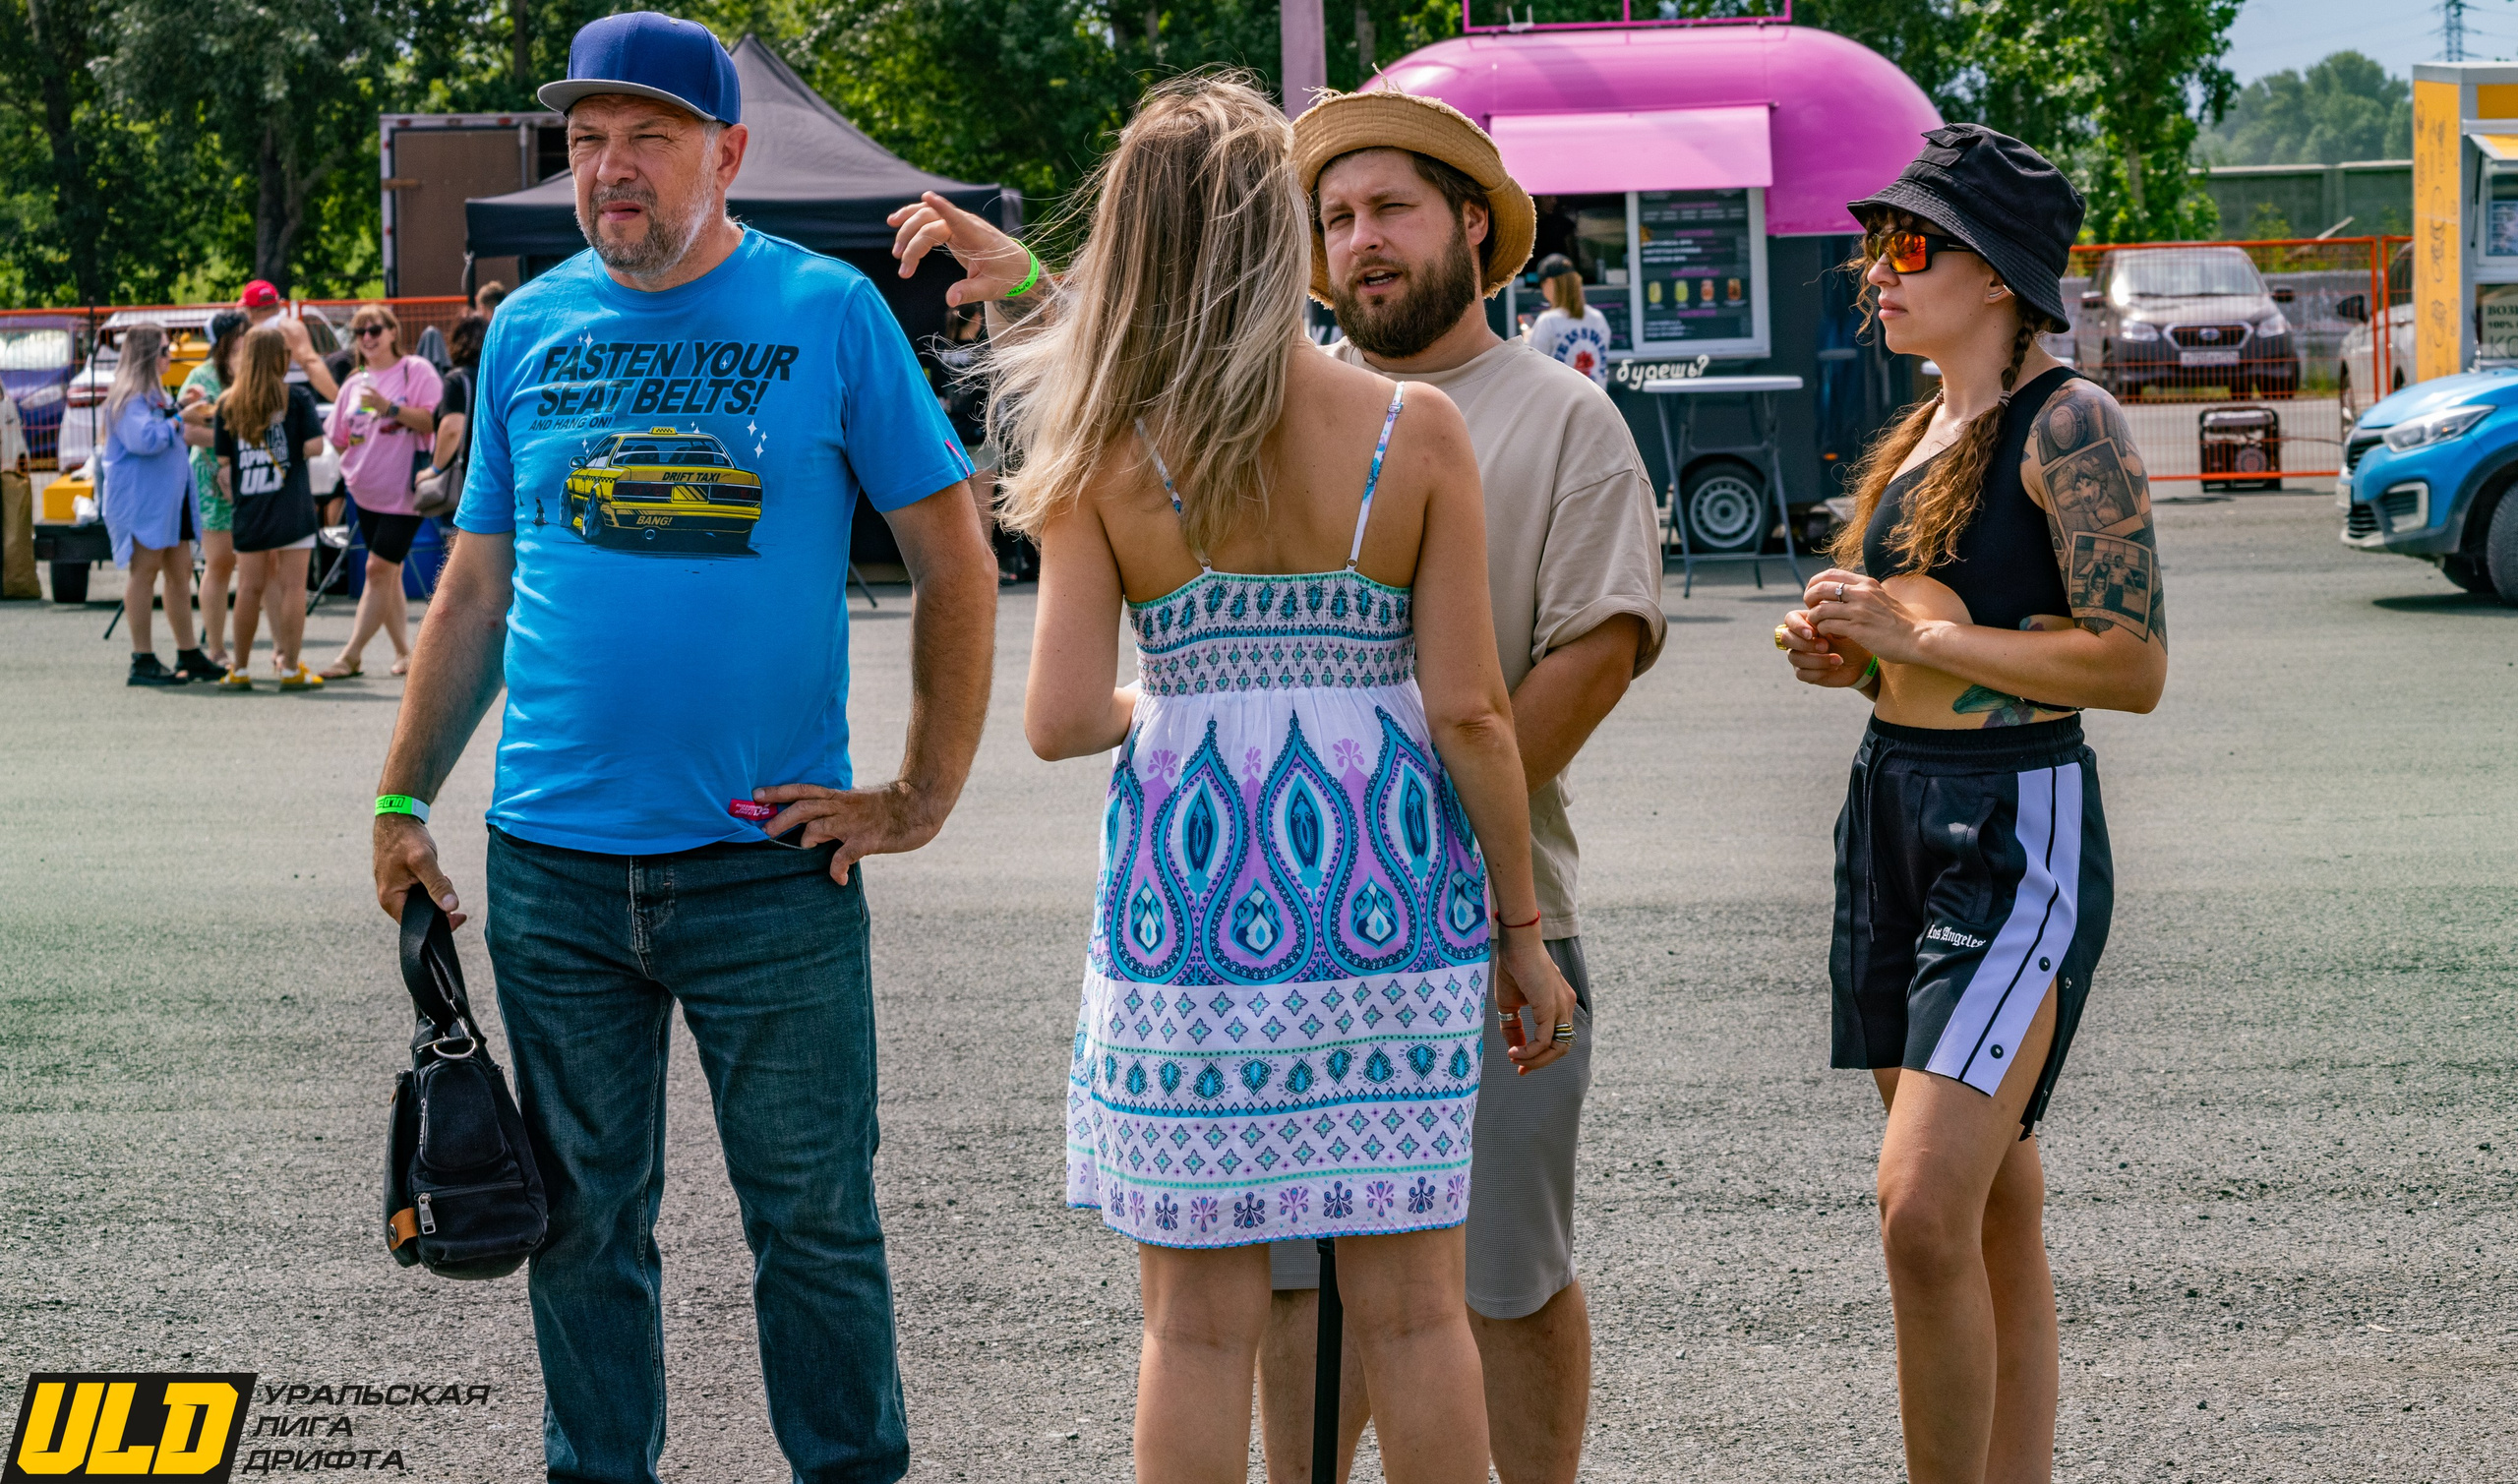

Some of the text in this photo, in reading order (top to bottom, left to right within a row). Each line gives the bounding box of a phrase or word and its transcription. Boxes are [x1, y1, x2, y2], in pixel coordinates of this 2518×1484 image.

[539, 341, 799, 383] FASTEN YOUR
[537, 379, 770, 417] SEAT BELTS!
[528, 417, 613, 432] AND HANG ON!
[662, 471, 721, 483] DRIFT TAXI
[635, 514, 673, 526] BANG!
